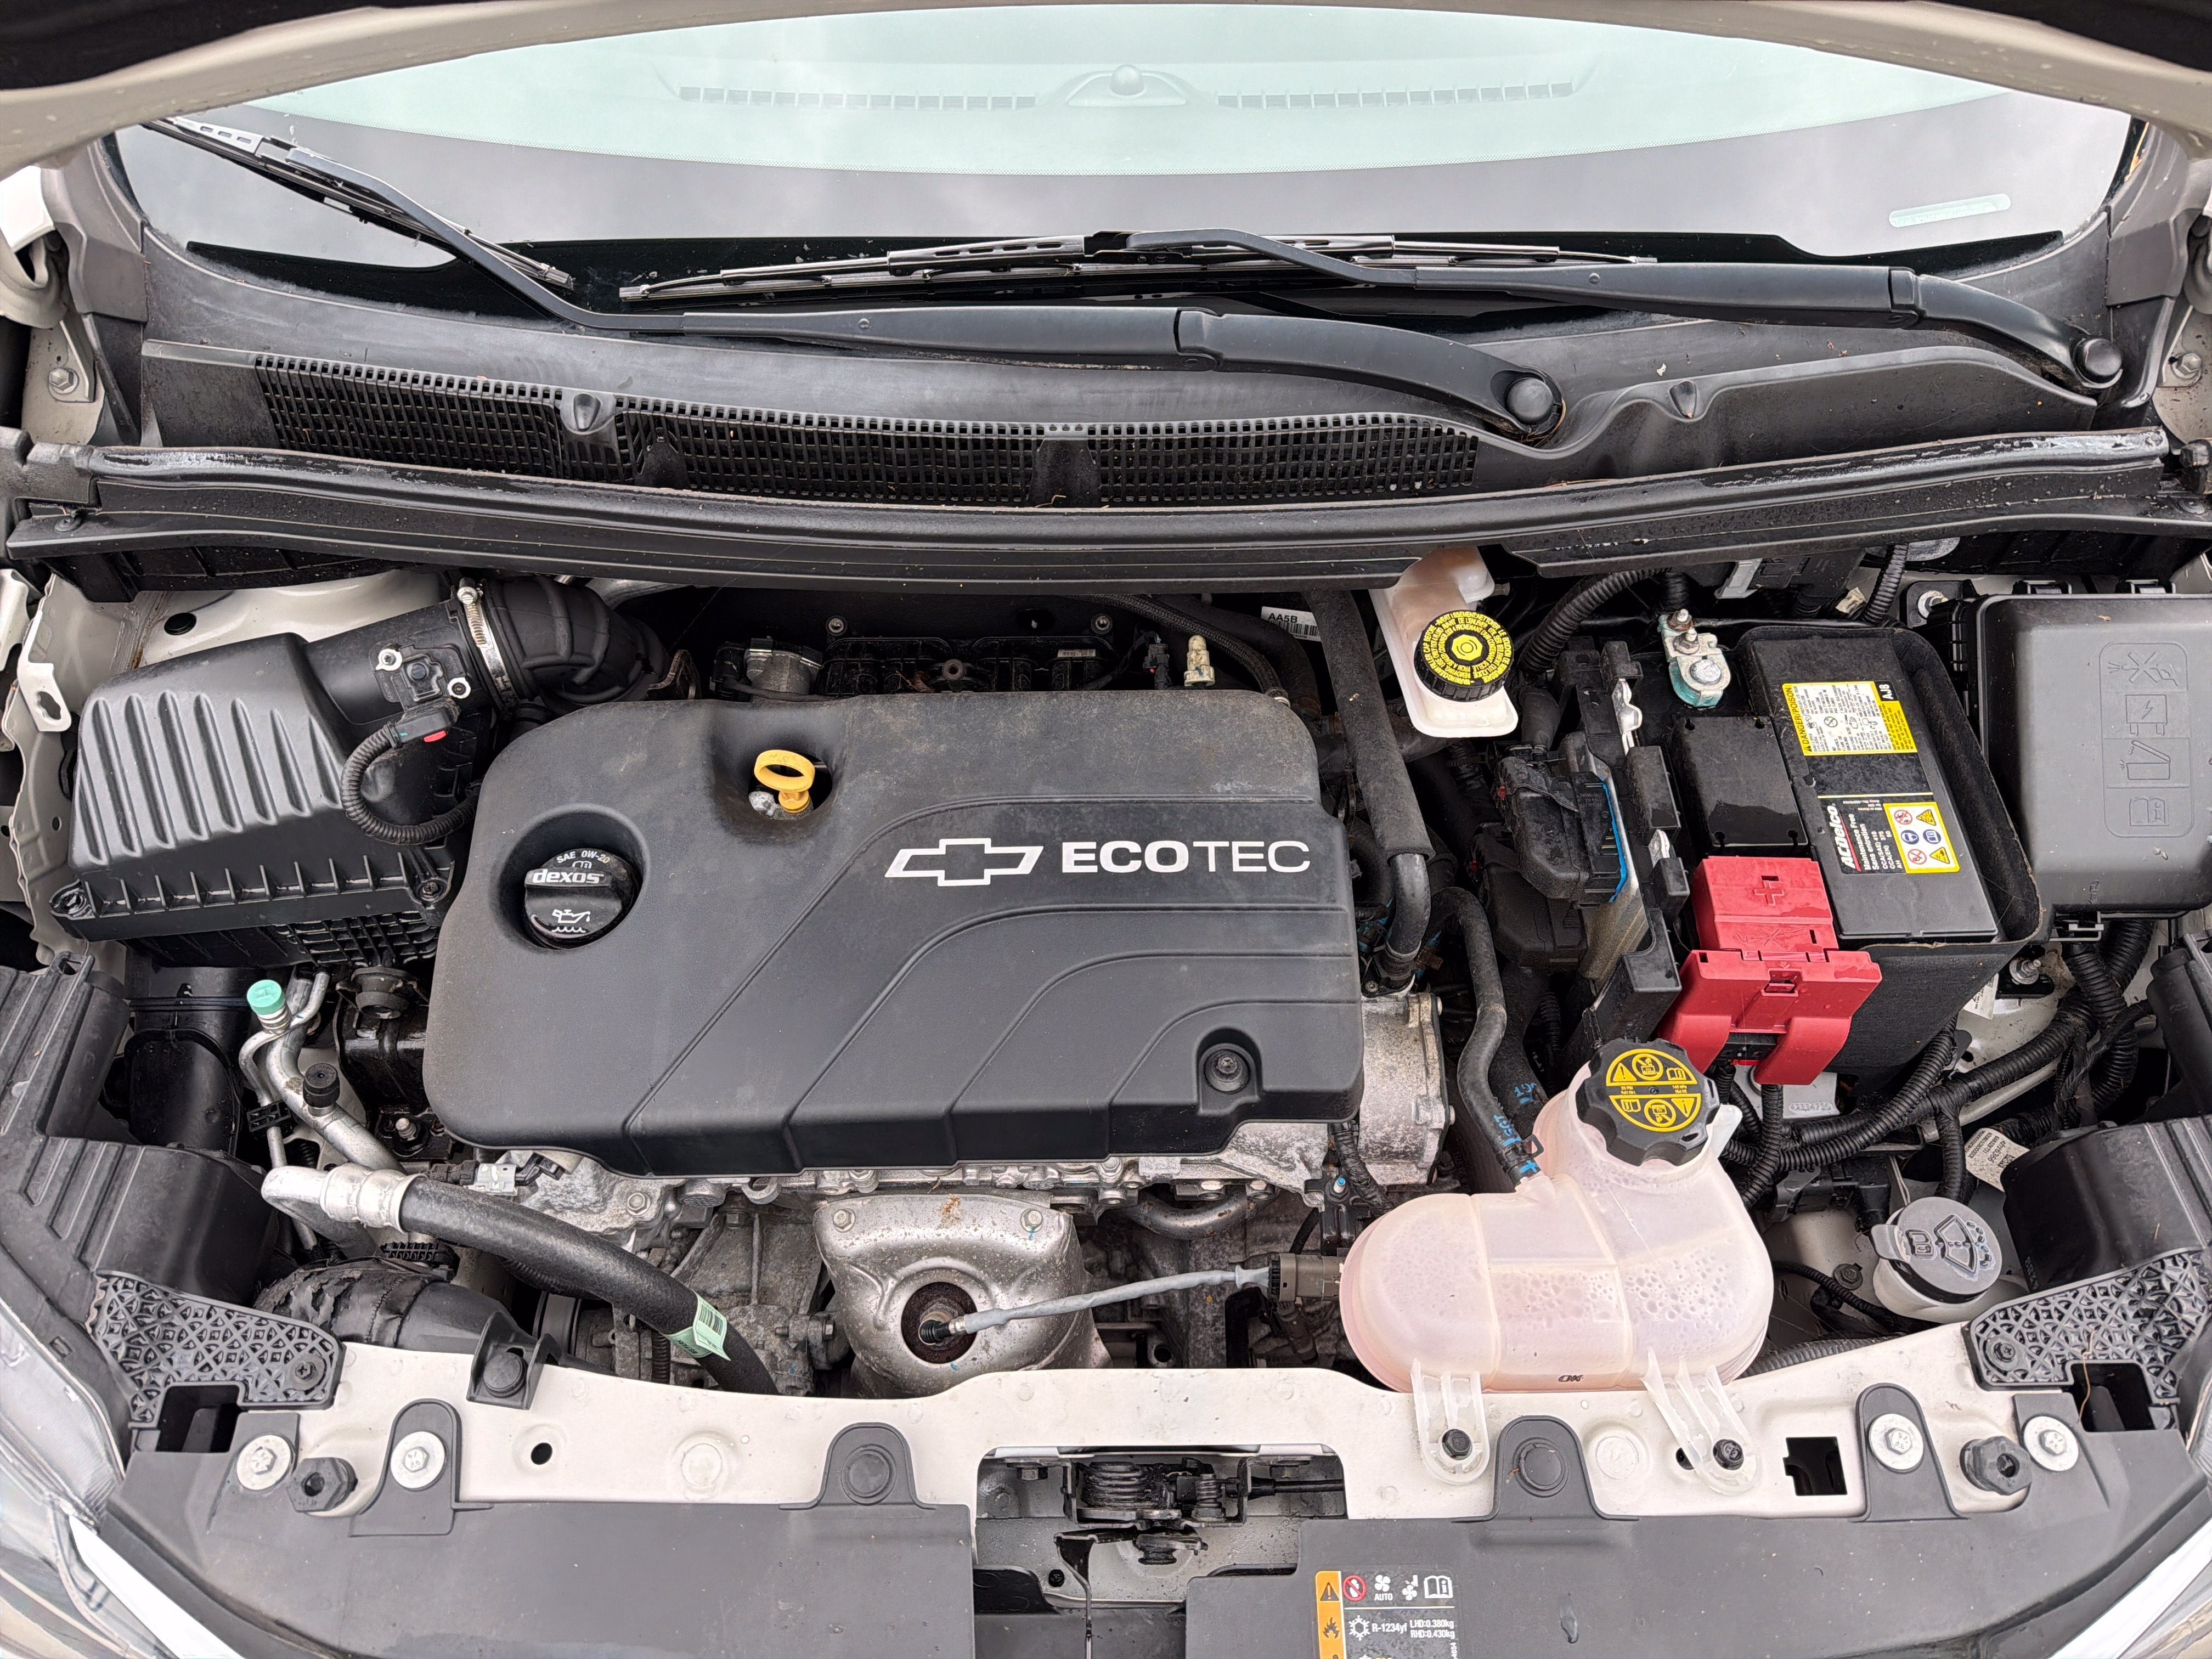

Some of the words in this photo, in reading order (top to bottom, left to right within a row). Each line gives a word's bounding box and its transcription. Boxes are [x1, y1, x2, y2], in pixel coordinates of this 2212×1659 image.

[1268, 613, 1297, 623] AA5B
[1424, 625, 1437, 642] BEFORE
[1785, 687, 1810, 744] DANGER/POISON
[1848, 814, 1858, 828] Free
[1827, 806, 1855, 868] ACDelco
[1860, 824, 1874, 852] entretien
[556, 851, 576, 864] SAE
[581, 850, 611, 864] 0W-20
[1062, 840, 1310, 873] ECOTEC
[1853, 830, 1871, 870] Maintenance
[1875, 842, 1888, 869] CCA(SAE)
[1883, 845, 1895, 869] CCA(EN)
[1870, 854, 1880, 870] Sans
[1896, 860, 1903, 869] AH
[533, 869, 601, 884] dexos
[1372, 1623, 1407, 1634] R-1234yf
[1409, 1620, 1454, 1629] LHD:0.380kg
[1410, 1630, 1455, 1639] RHD:0.430kg
